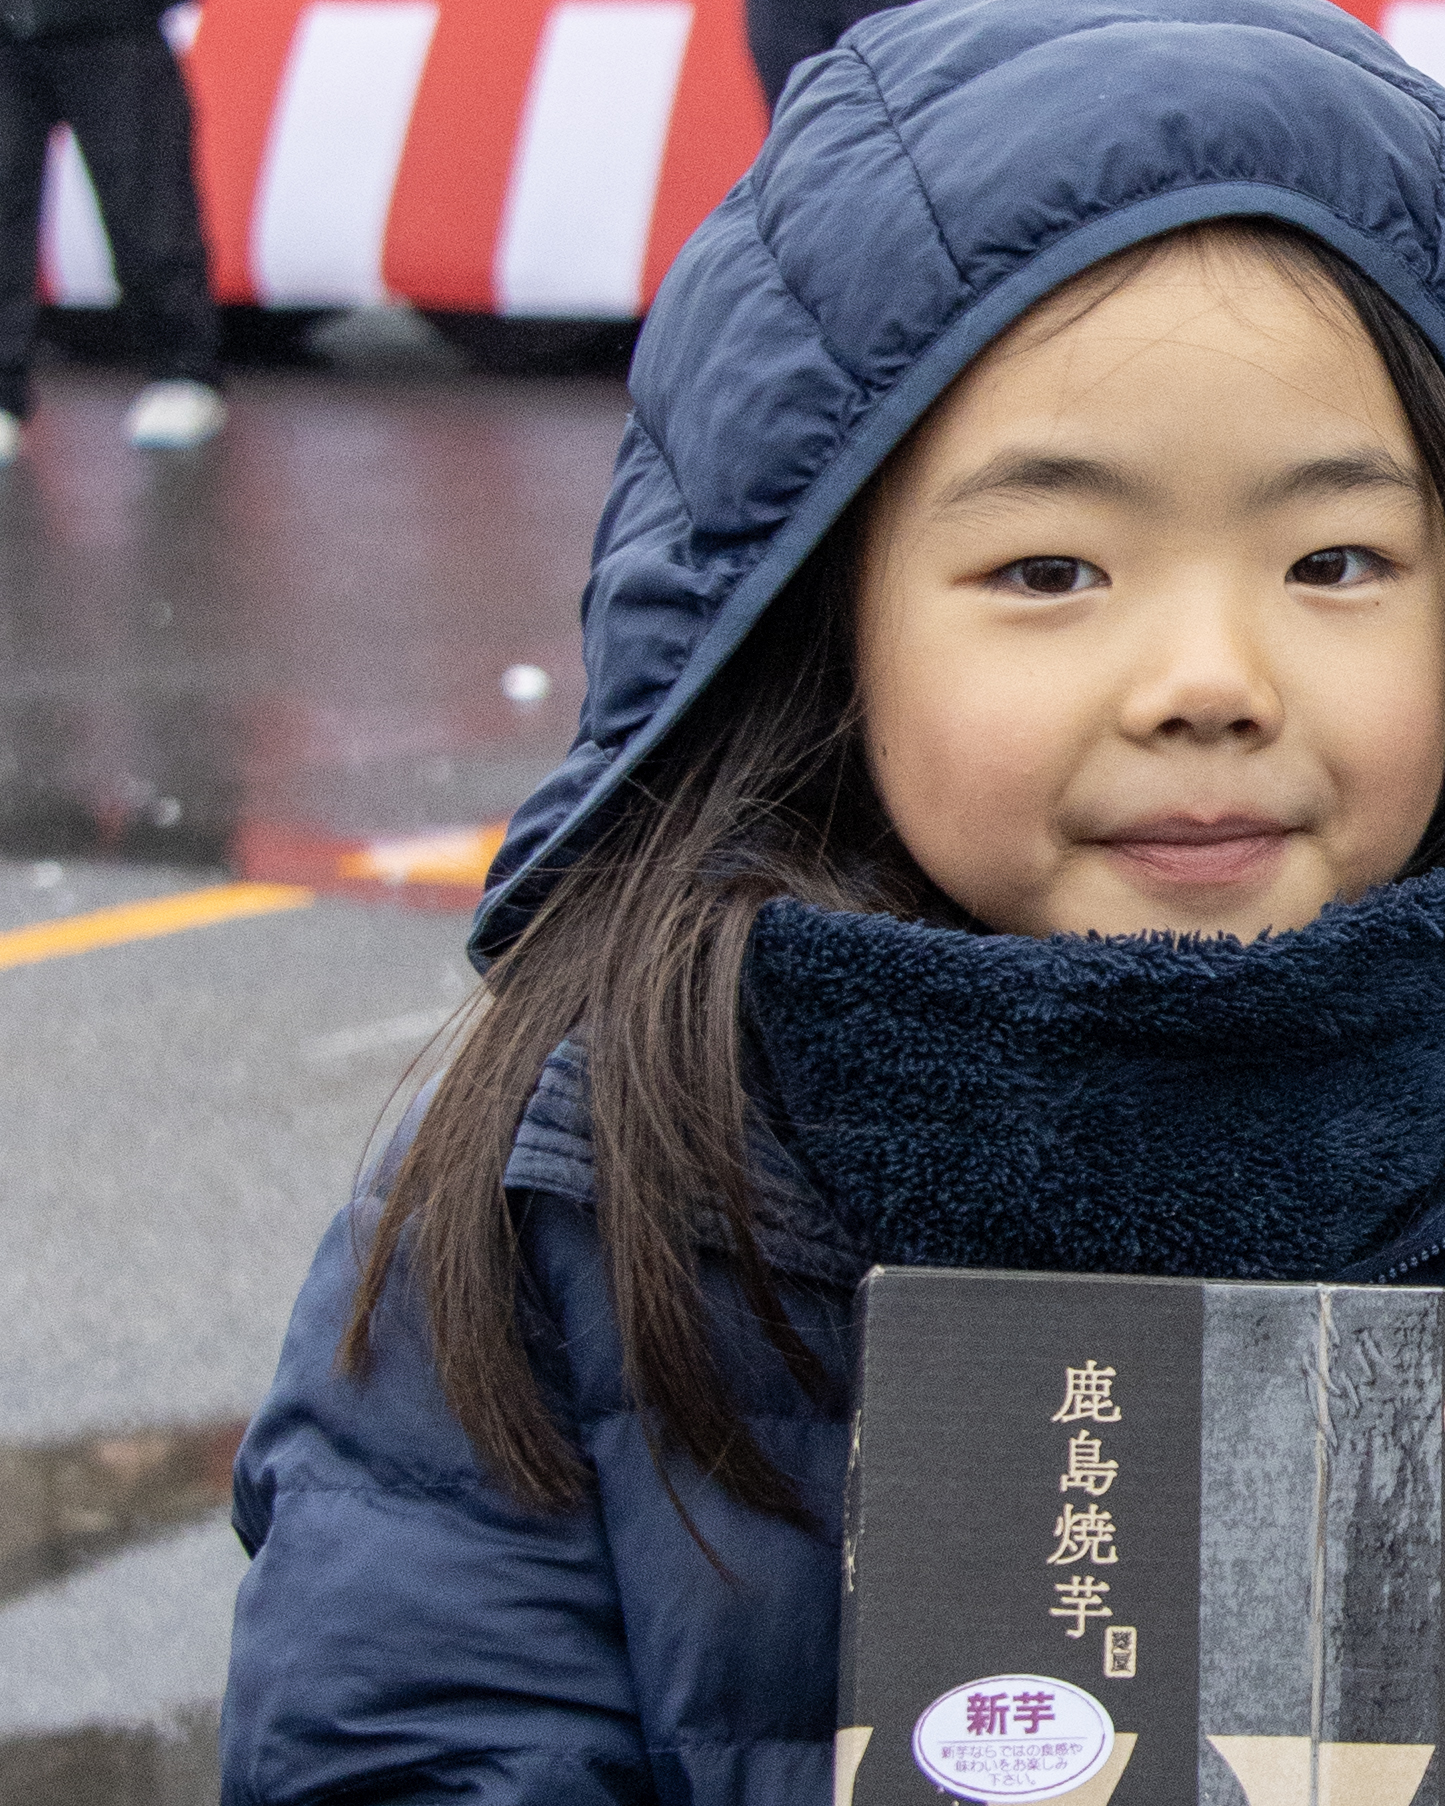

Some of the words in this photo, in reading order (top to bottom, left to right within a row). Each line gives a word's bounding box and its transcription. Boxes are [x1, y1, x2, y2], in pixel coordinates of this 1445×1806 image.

[1046, 1359, 1122, 1639] 鹿島焼芋
[966, 1691, 1056, 1736] 新芋
